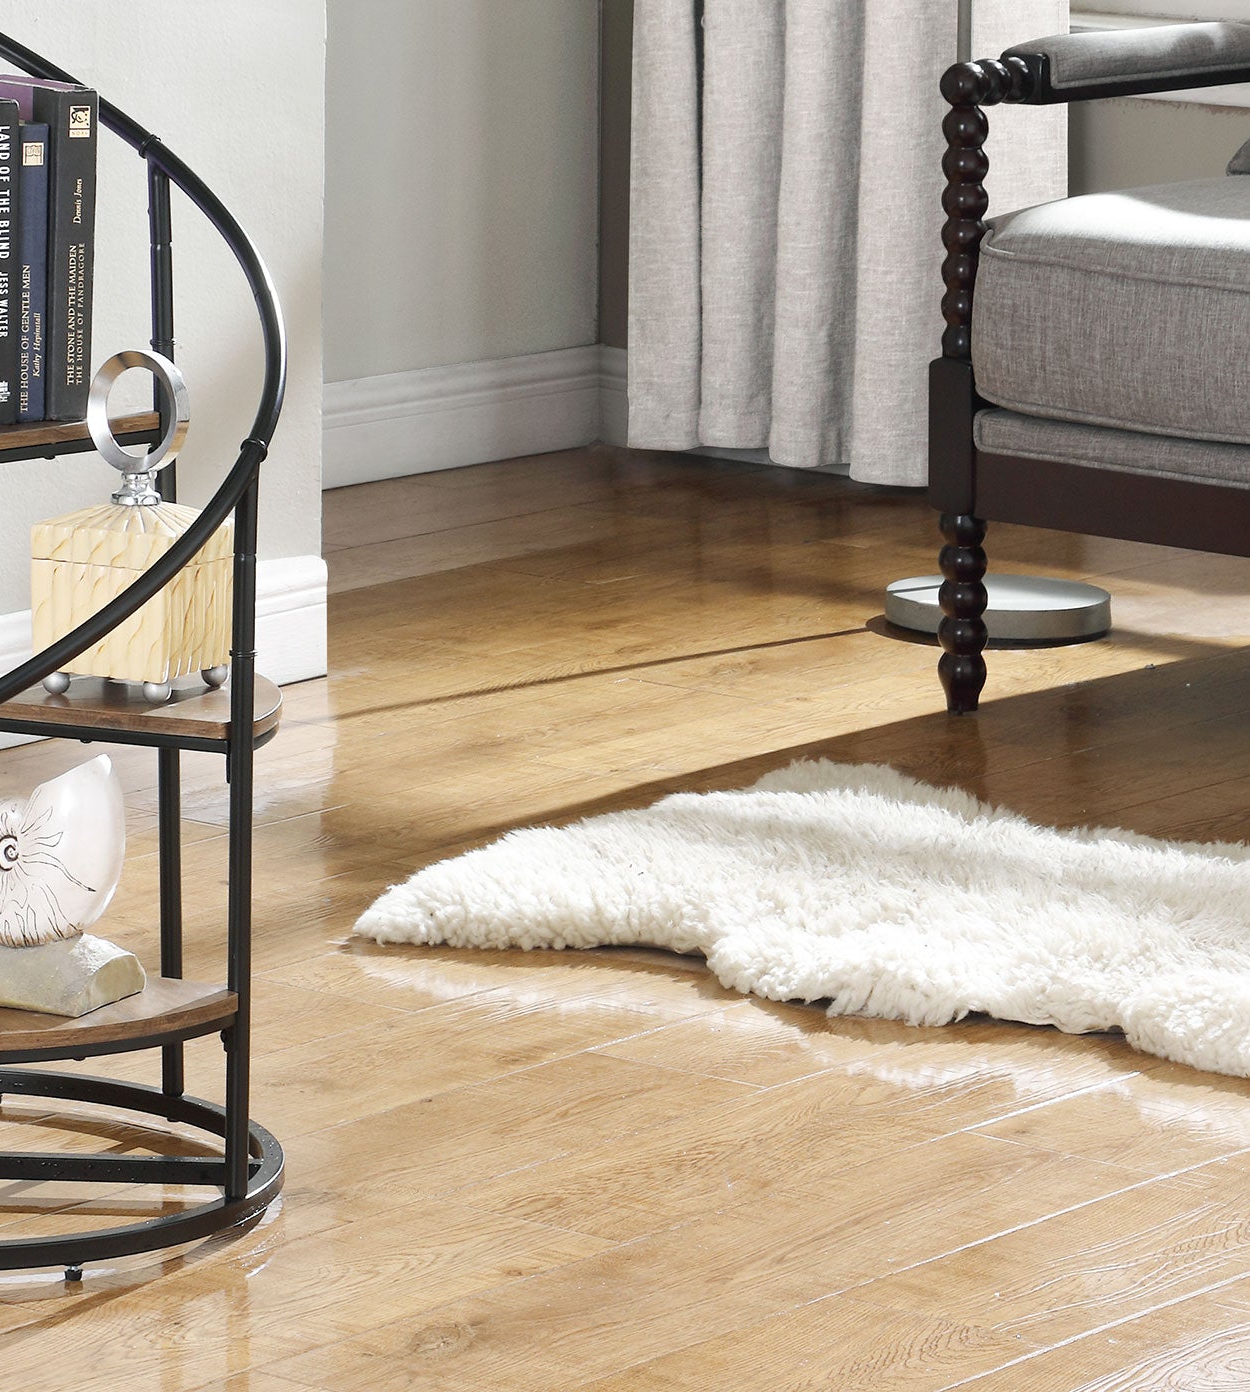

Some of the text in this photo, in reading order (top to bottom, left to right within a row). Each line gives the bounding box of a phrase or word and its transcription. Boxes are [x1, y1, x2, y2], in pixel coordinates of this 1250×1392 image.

[73, 178, 83, 224] Dennis Jones
[77, 242, 86, 308] PANDRAGORE
[20, 264, 31, 414] THE HOUSE OF GENTLE MEN
[32, 312, 43, 377] Kathy Hepinstall
[67, 245, 77, 386] THE STONE AND THE MAIDEN
[76, 329, 84, 361] HOUSE
[77, 312, 84, 326] OF
